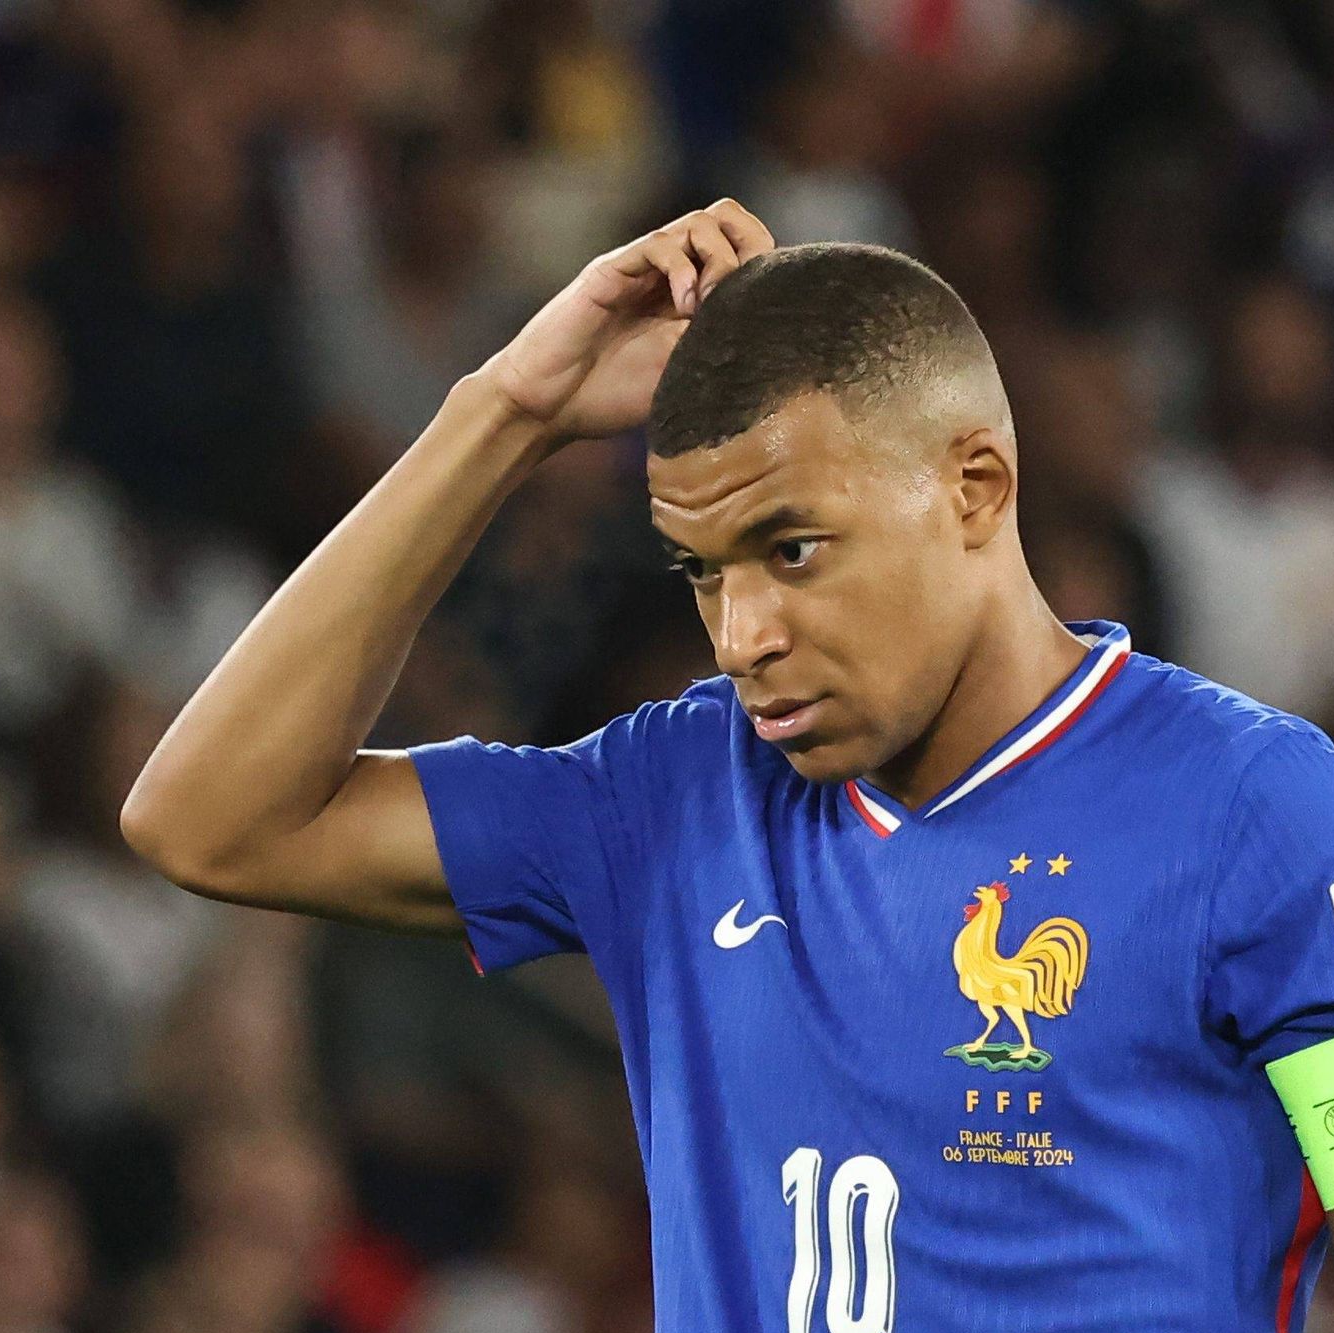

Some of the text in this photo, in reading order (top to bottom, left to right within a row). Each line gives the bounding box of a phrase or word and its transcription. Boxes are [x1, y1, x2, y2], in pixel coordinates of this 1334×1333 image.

[959, 1130, 1003, 1147] FRANCE
[1016, 1132, 1052, 1148] ITALIE
[943, 1146, 1074, 1166] 06 SEPTEMBRE 2024
